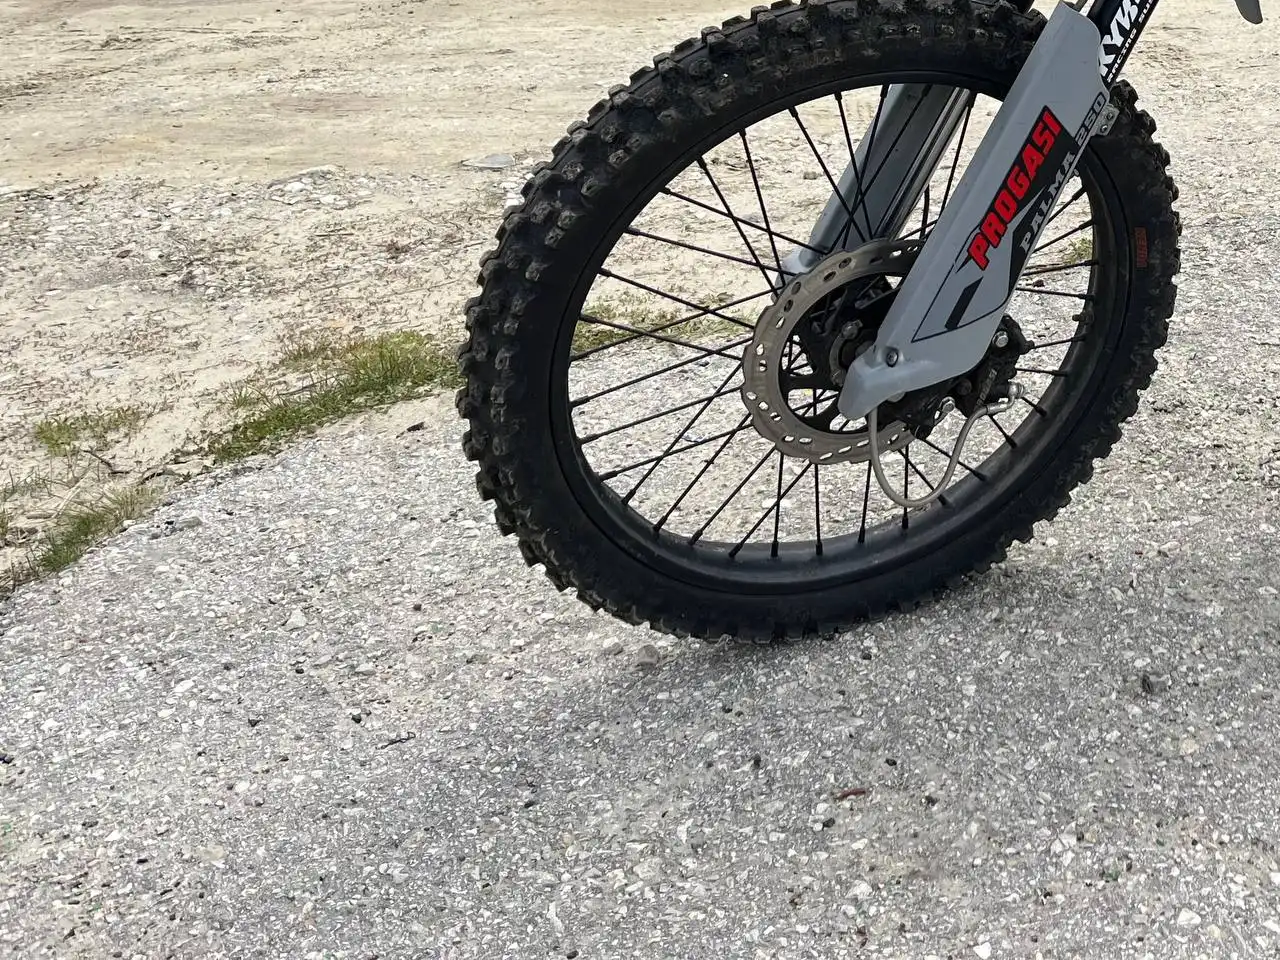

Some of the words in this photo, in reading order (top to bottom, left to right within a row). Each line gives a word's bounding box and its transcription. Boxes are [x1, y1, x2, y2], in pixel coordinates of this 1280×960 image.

[967, 110, 1062, 271] PROGASI
[1020, 151, 1076, 253] PALMA
[1075, 93, 1107, 147] 250
